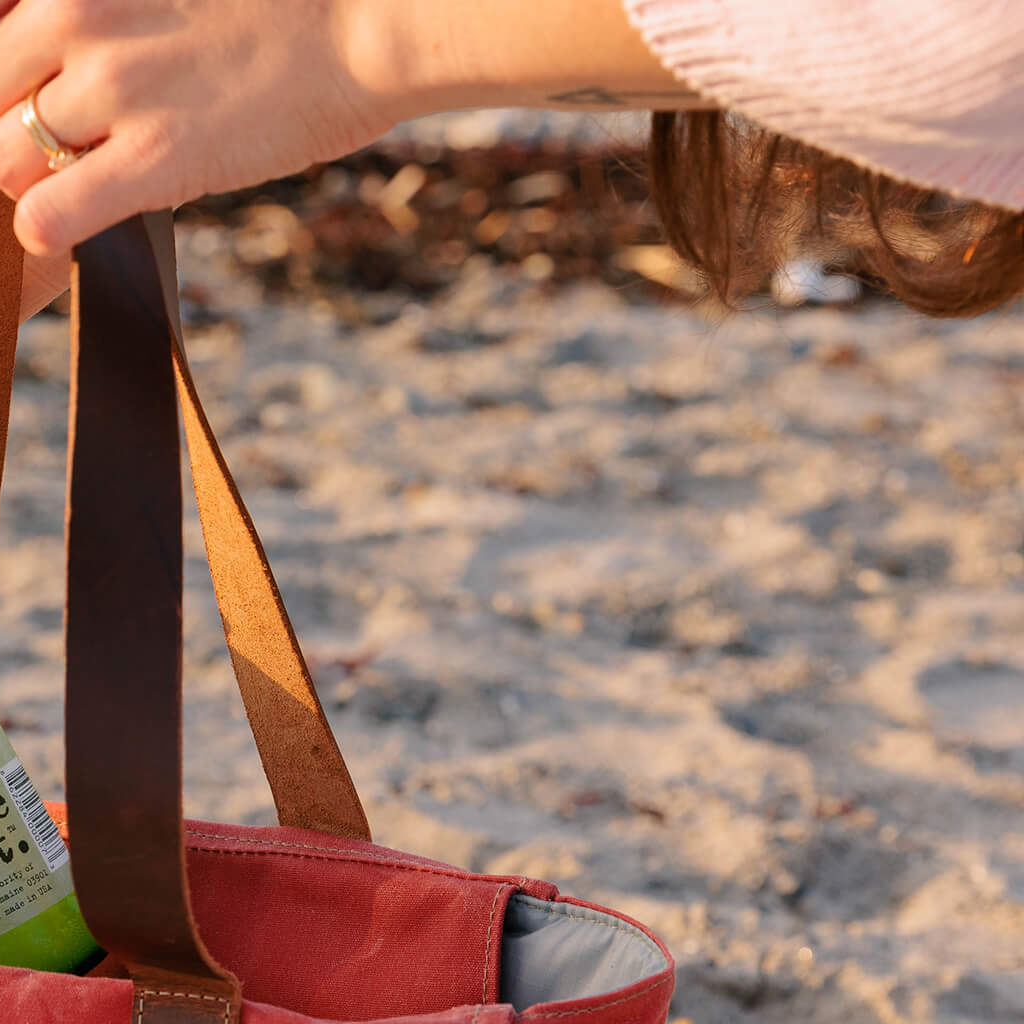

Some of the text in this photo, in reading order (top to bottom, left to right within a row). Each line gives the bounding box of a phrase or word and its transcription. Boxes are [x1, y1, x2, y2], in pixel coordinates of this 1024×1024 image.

[0, 886, 25, 905] maine
[4, 901, 25, 917] made
[26, 893, 38, 906] in
